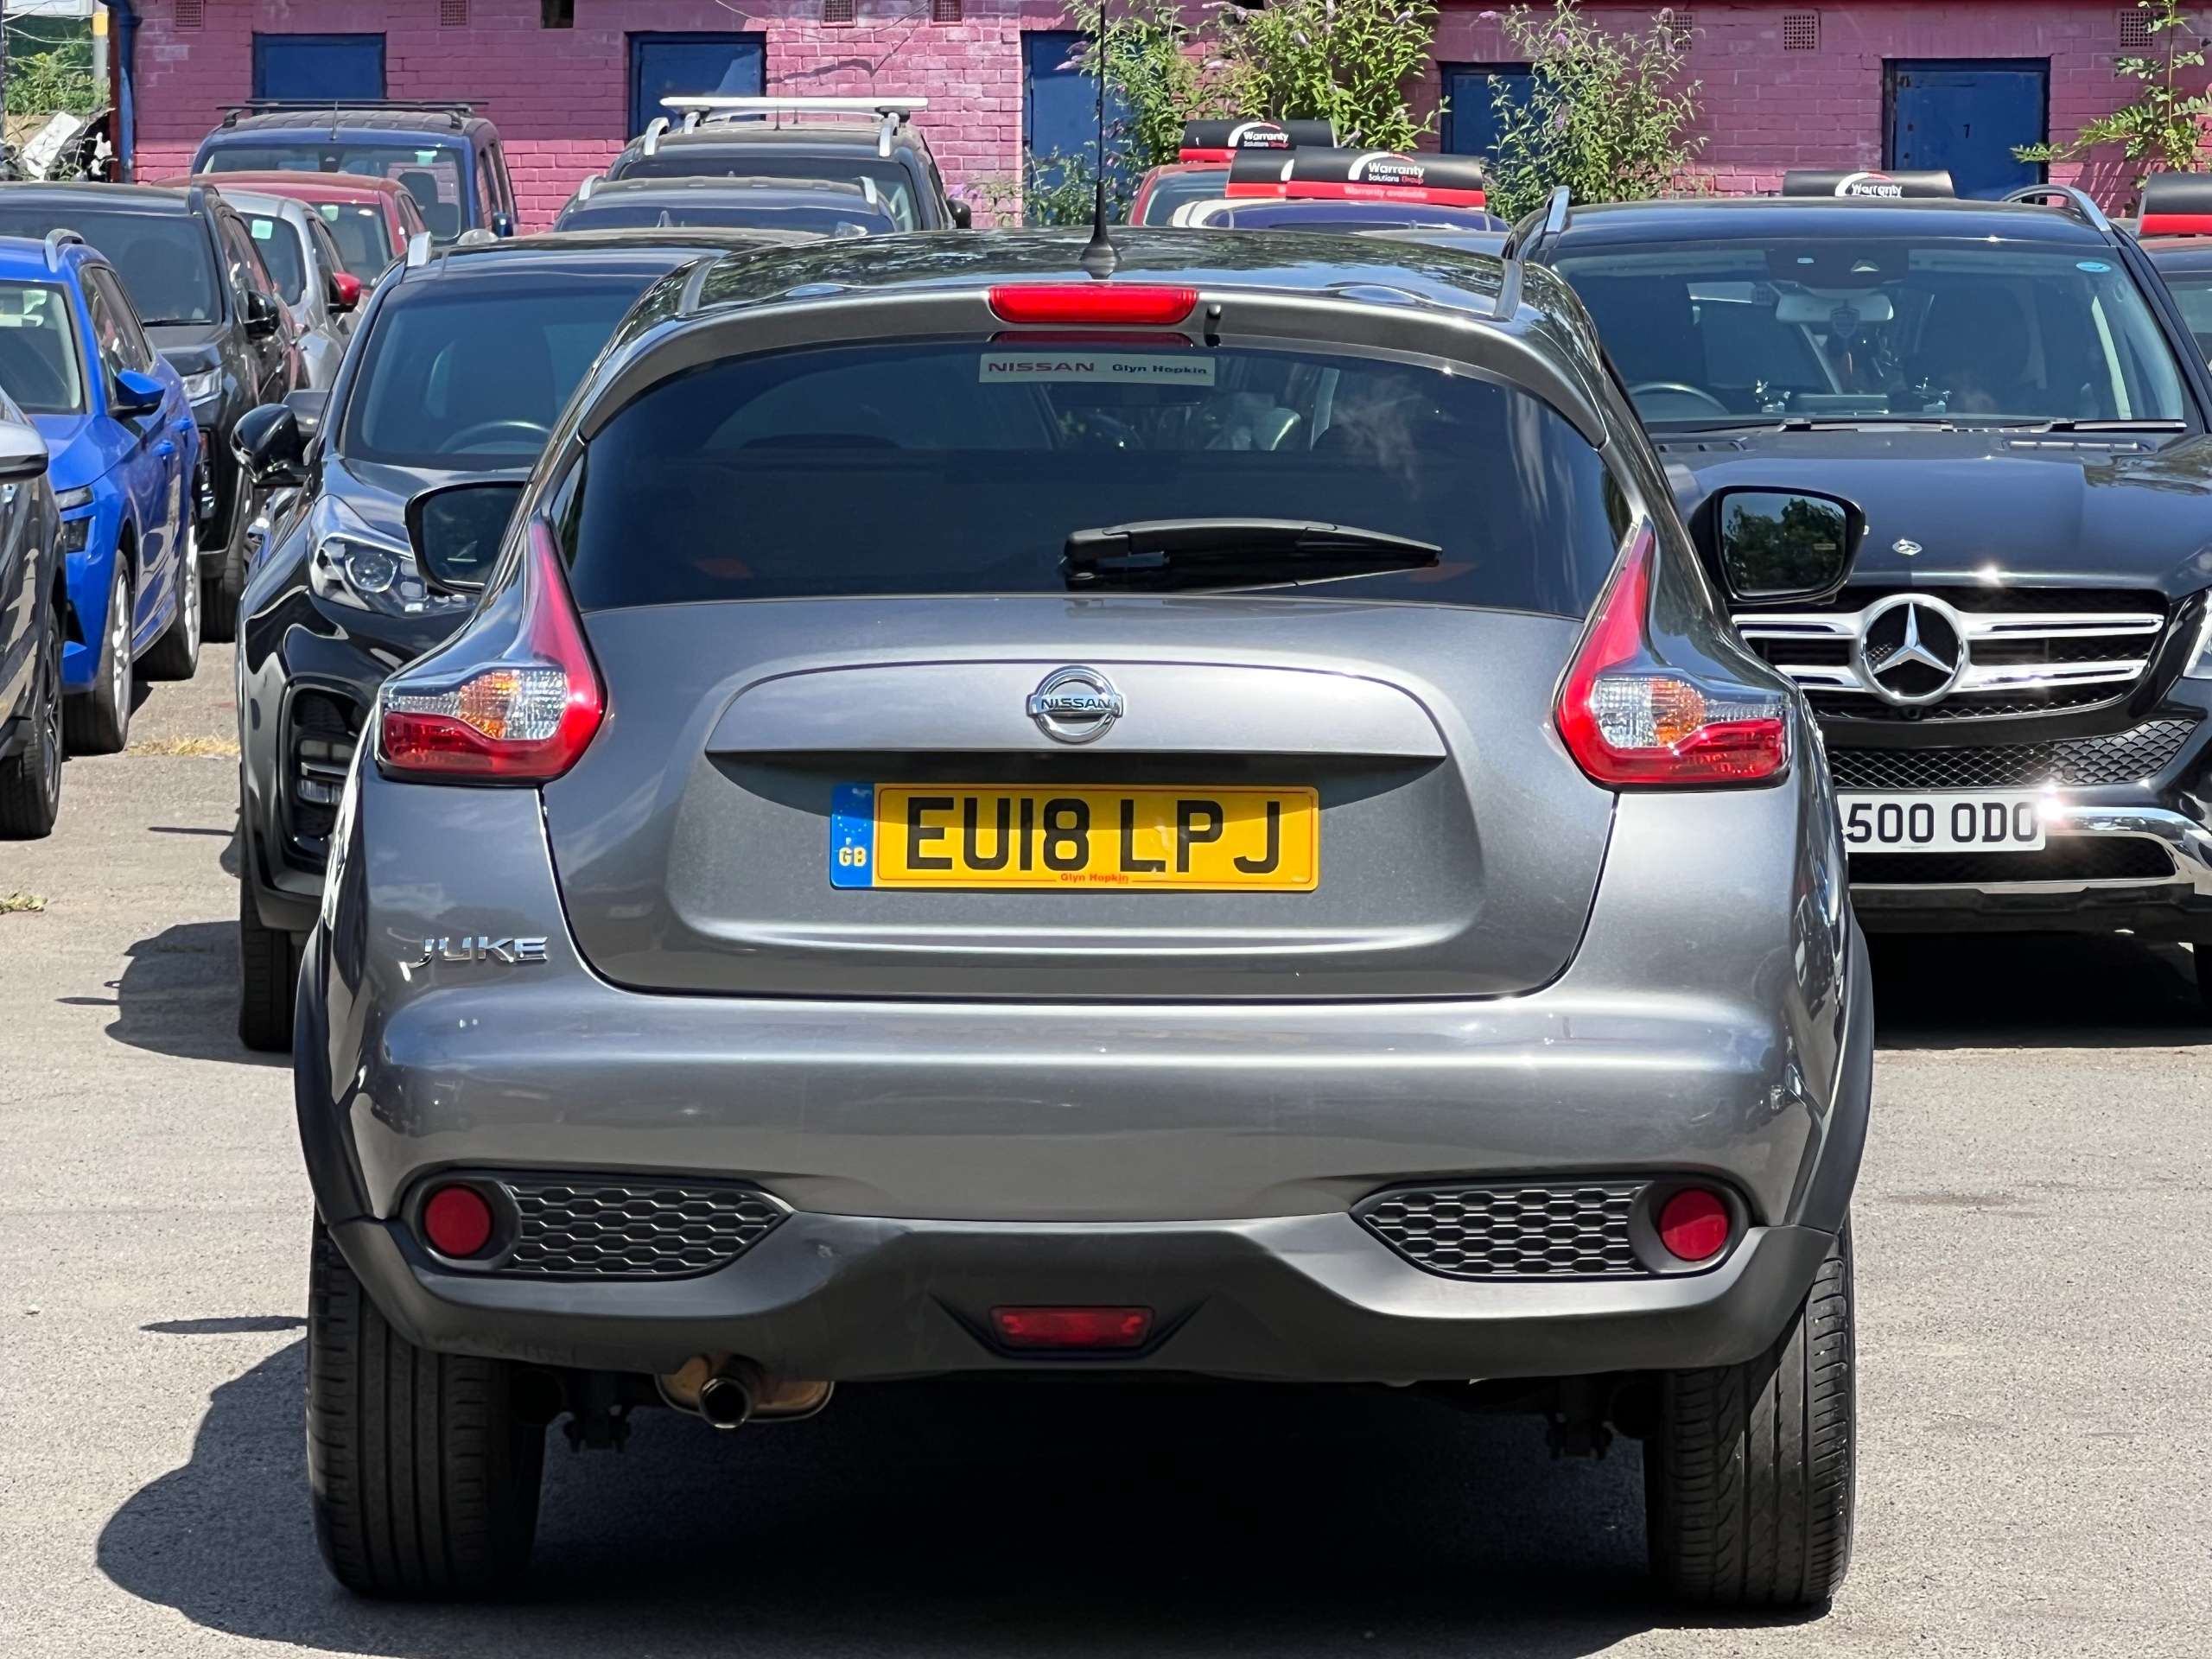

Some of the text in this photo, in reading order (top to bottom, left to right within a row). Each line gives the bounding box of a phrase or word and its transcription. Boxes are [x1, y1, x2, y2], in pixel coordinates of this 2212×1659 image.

[1243, 130, 1289, 143] Warranty
[1368, 162, 1425, 178] Warranty
[1368, 174, 1400, 183] Solutions
[1852, 183, 1903, 198] Warranty
[988, 361, 1207, 375] NISSAN Glyn Hopkin
[1040, 697, 1111, 711] NISSAN
[1846, 803, 1935, 844] 500
[906, 796, 1091, 872] EU18
[839, 847, 867, 867] GB
[1060, 873, 1128, 884] Glyn Hopkin
[399, 936, 549, 982] JUKE
